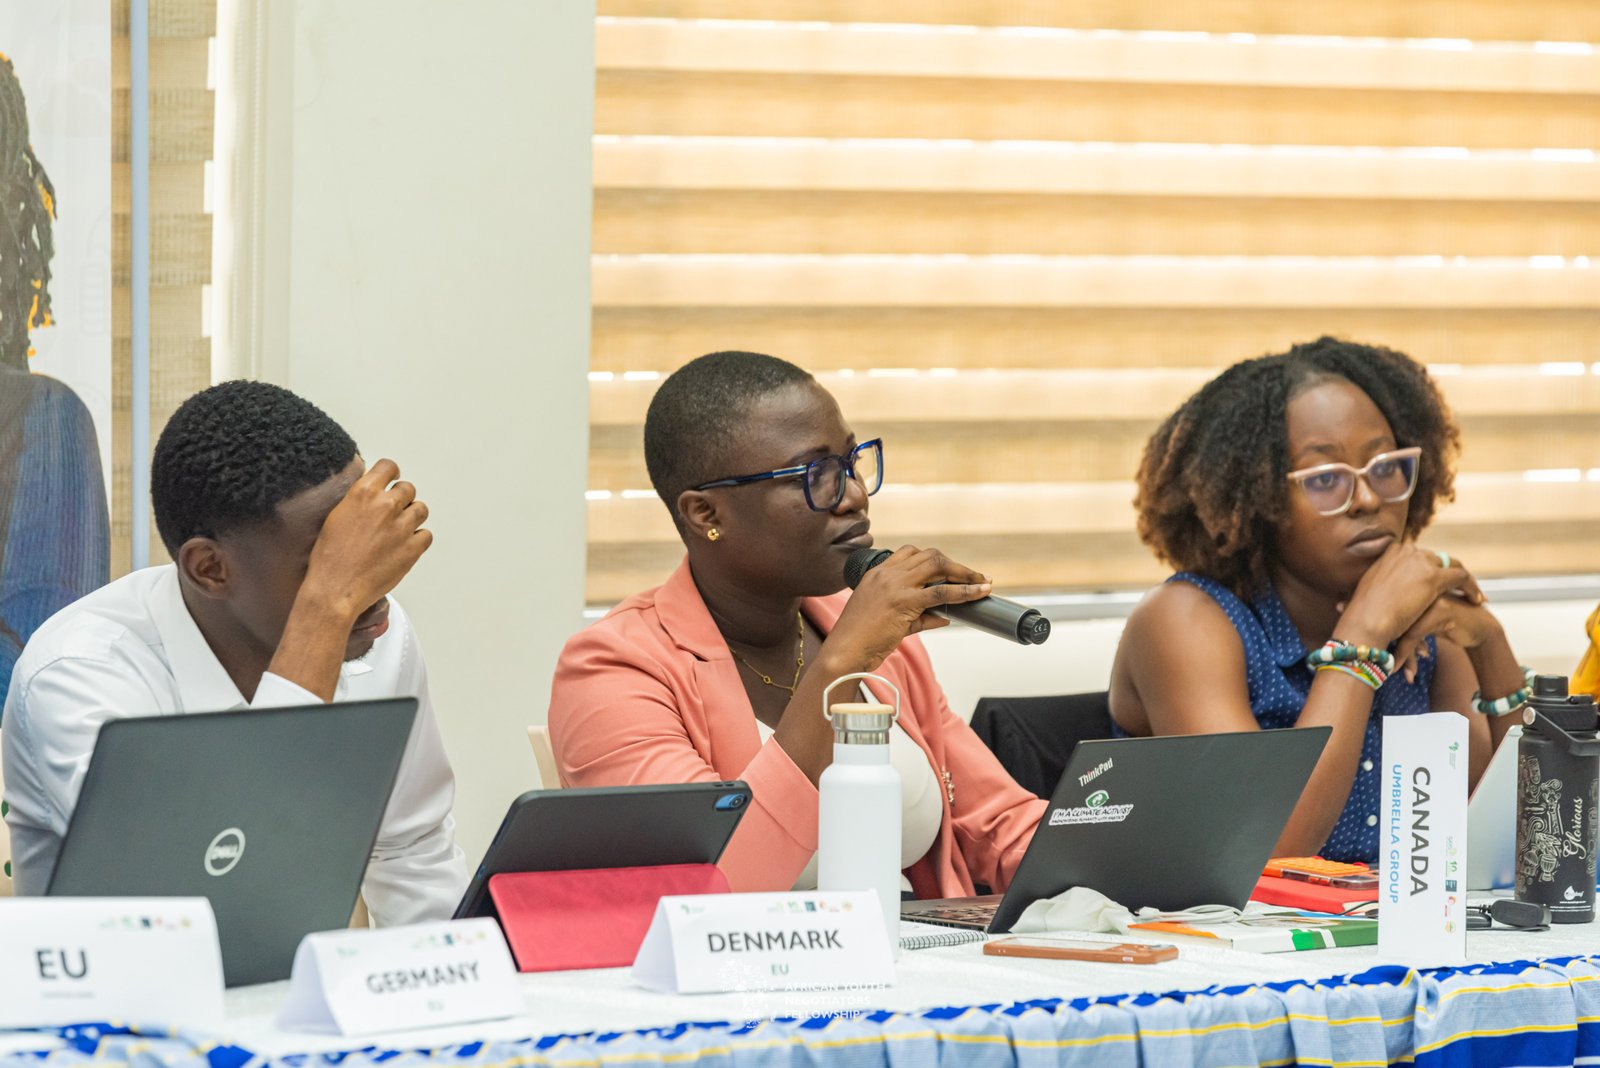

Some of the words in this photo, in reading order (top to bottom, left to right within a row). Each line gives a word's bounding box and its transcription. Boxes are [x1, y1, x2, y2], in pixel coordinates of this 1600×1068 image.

[1078, 757, 1114, 787] ThinkPad
[1072, 808, 1101, 817] CLIMATE
[1101, 806, 1131, 816] ACTIVIST
[1391, 764, 1403, 845] UMBRELLA
[1410, 766, 1431, 896] CANADA
[1562, 796, 1586, 859] Glorious
[1389, 849, 1400, 904] GROUP
[707, 929, 843, 953] DENMARK
[36, 947, 89, 980] EU
[366, 960, 480, 994] GERMANY
[771, 963, 789, 976] EU
